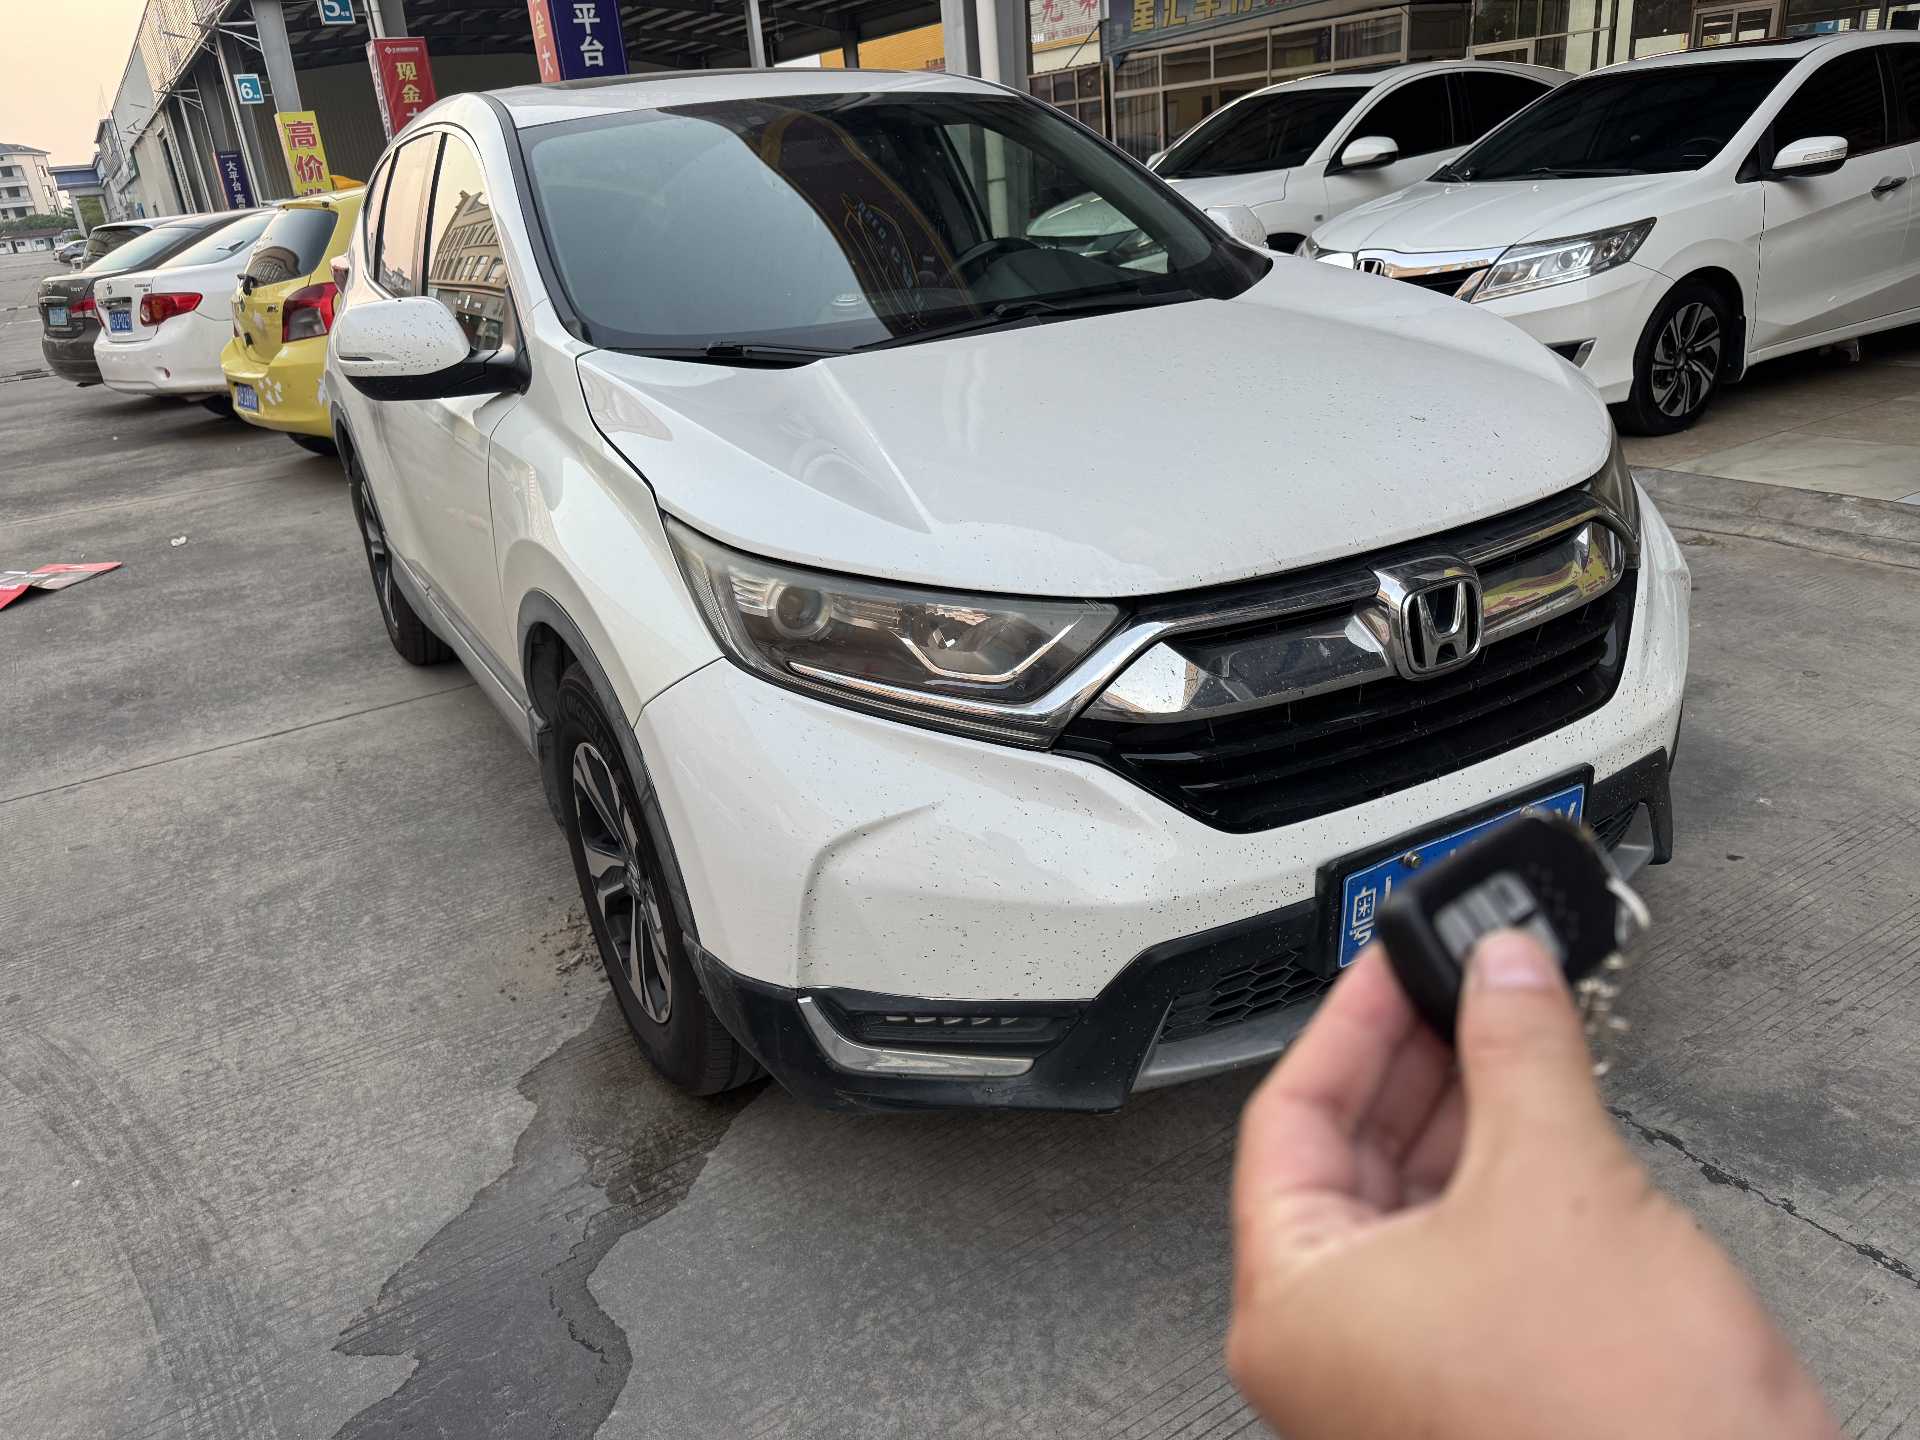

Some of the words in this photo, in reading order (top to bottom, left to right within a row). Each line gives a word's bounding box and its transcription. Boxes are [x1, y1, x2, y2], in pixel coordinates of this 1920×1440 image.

[323, 0, 341, 17] 5
[572, 3, 604, 67] 平台
[240, 82, 254, 99] 6
[284, 121, 323, 195] 高价
